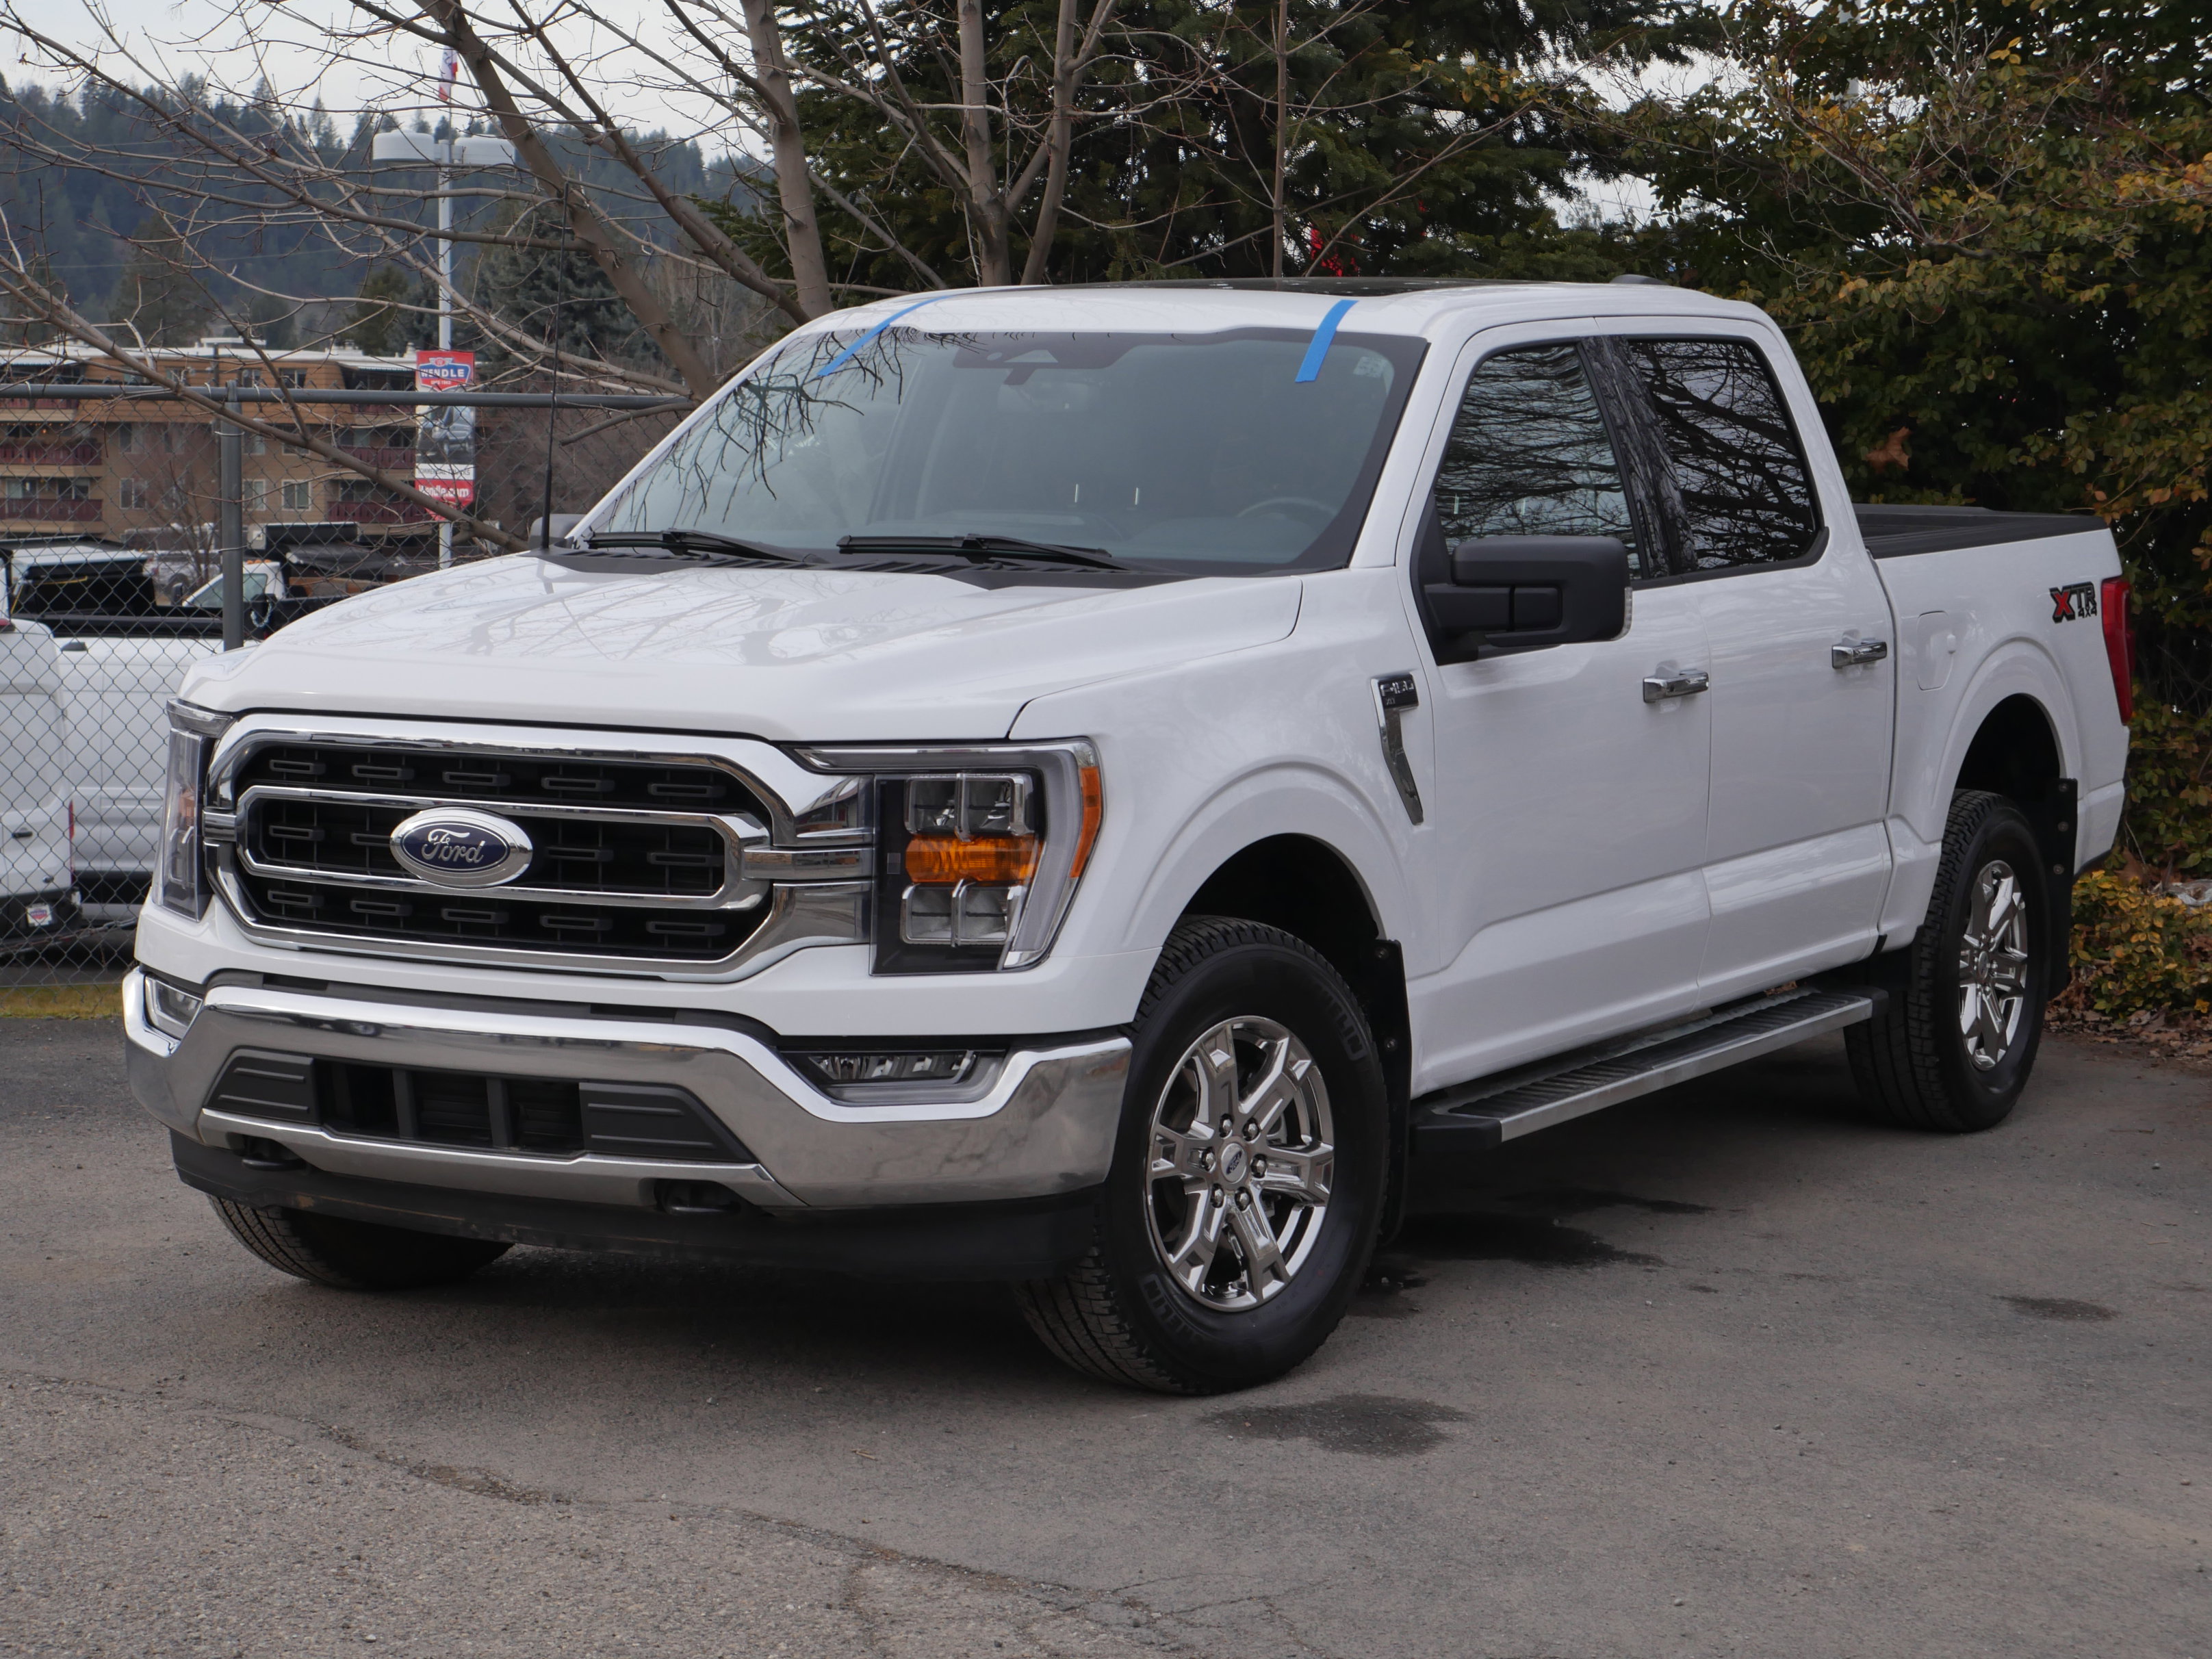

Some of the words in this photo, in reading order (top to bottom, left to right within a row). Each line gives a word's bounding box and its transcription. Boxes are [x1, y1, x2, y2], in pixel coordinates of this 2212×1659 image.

[421, 368, 465, 378] WENDLE
[2049, 581, 2097, 623] XTR
[421, 828, 486, 863] Ford
